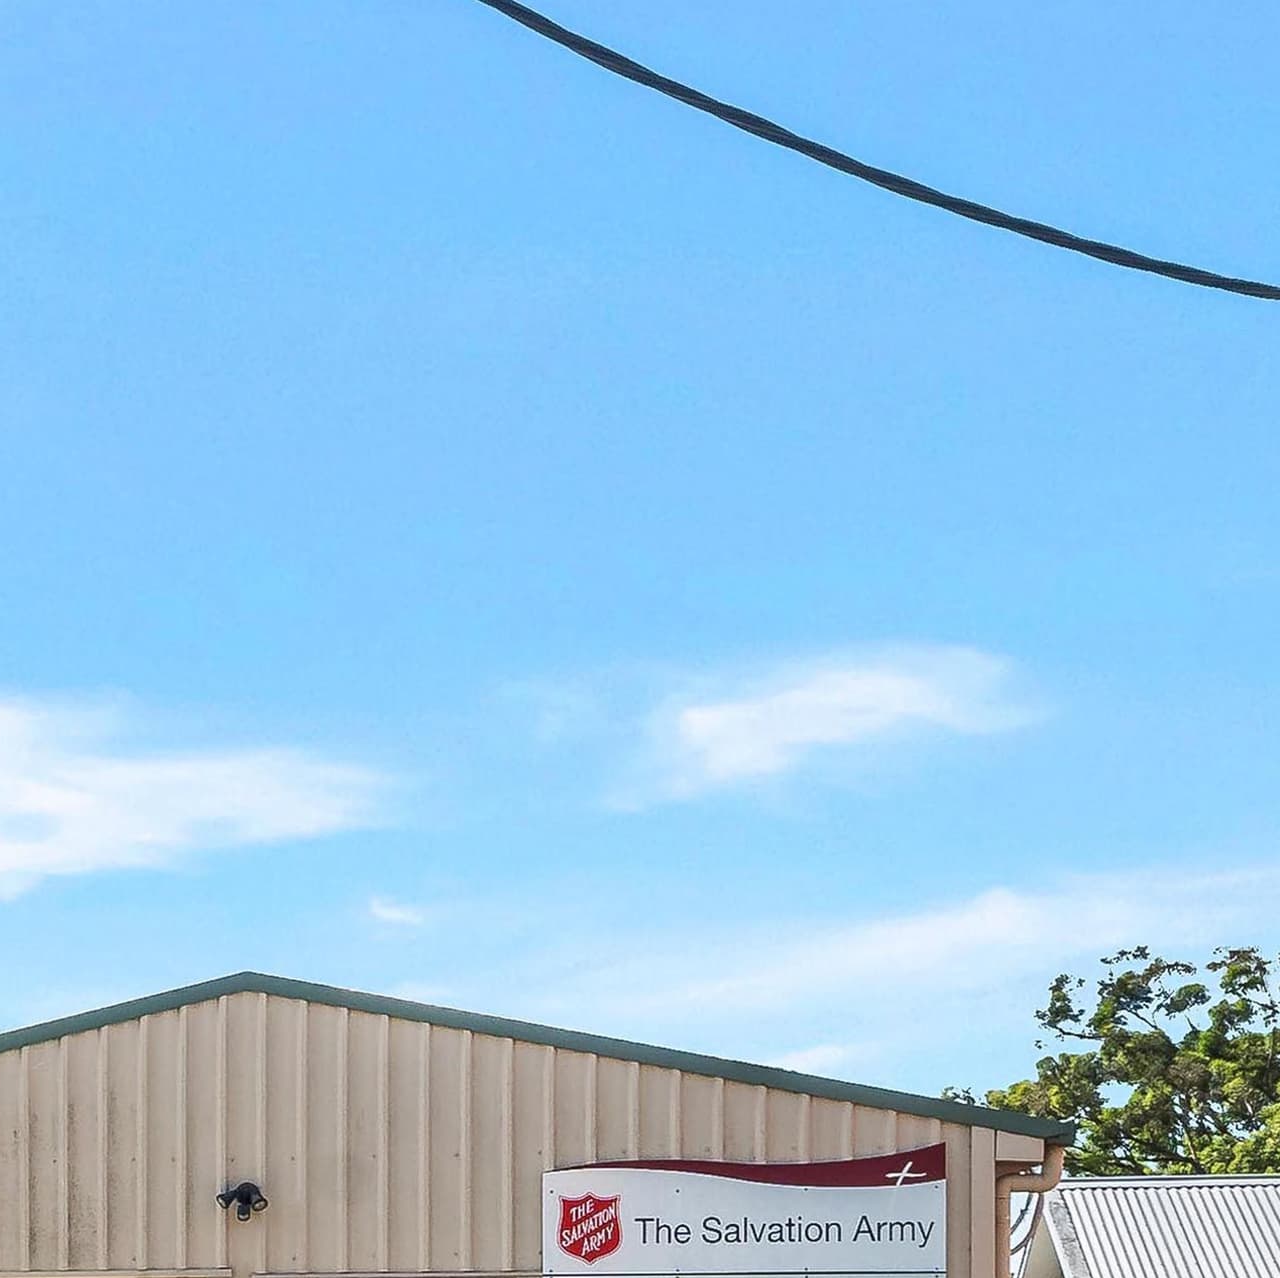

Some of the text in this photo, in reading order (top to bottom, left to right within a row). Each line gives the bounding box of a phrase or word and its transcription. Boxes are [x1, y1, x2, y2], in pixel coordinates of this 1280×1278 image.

[562, 1201, 616, 1248] SALVATION
[569, 1198, 594, 1222] THE
[581, 1222, 614, 1257] ARMY
[634, 1215, 935, 1248] The Salvation Army
